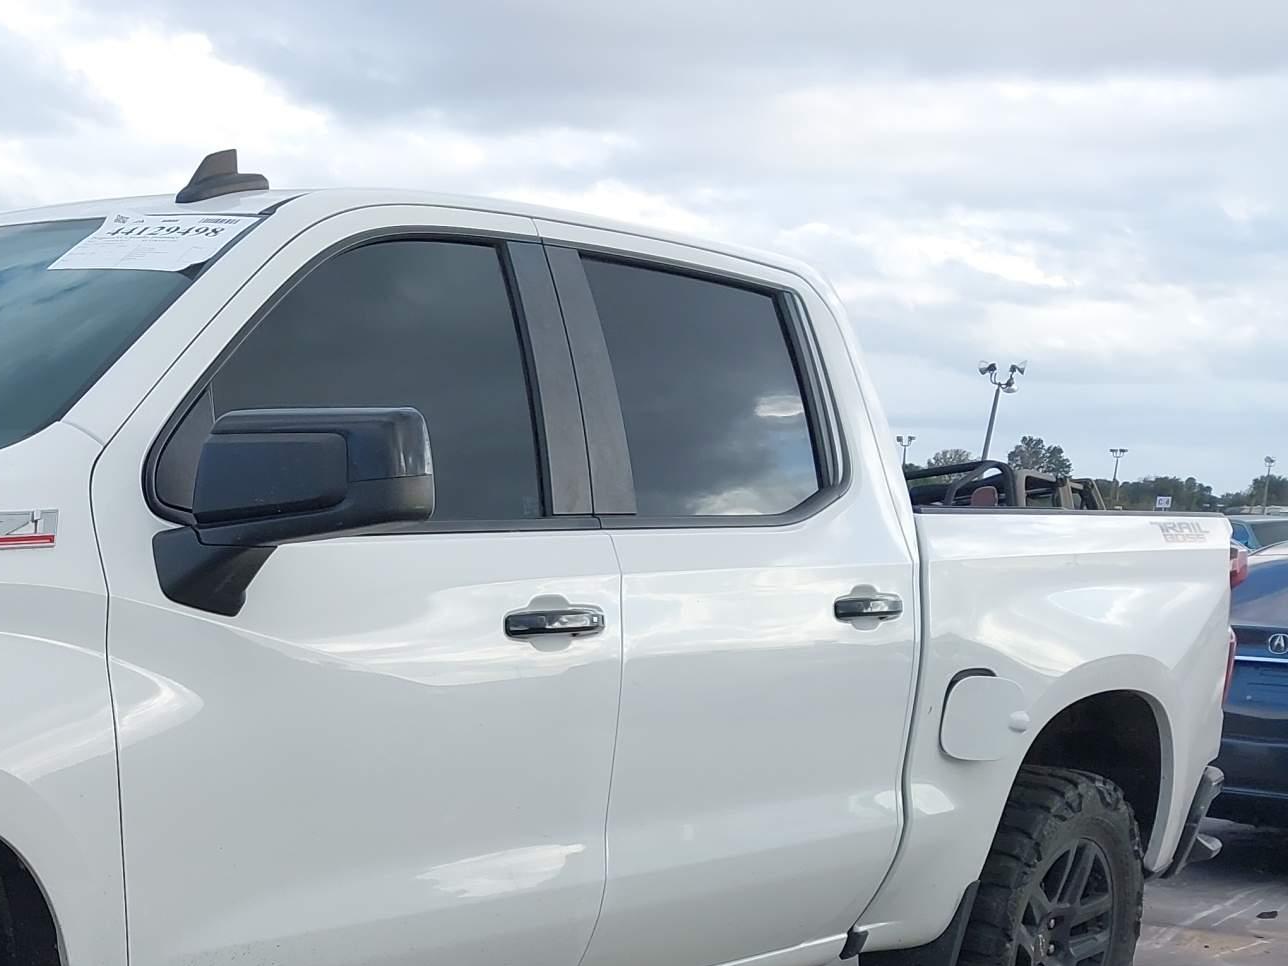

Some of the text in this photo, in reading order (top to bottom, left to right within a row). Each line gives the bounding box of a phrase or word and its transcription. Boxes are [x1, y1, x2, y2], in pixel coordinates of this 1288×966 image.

[106, 226, 225, 238] 44129498
[1149, 521, 1210, 534] TRAIL
[1162, 533, 1208, 544] BOSS
